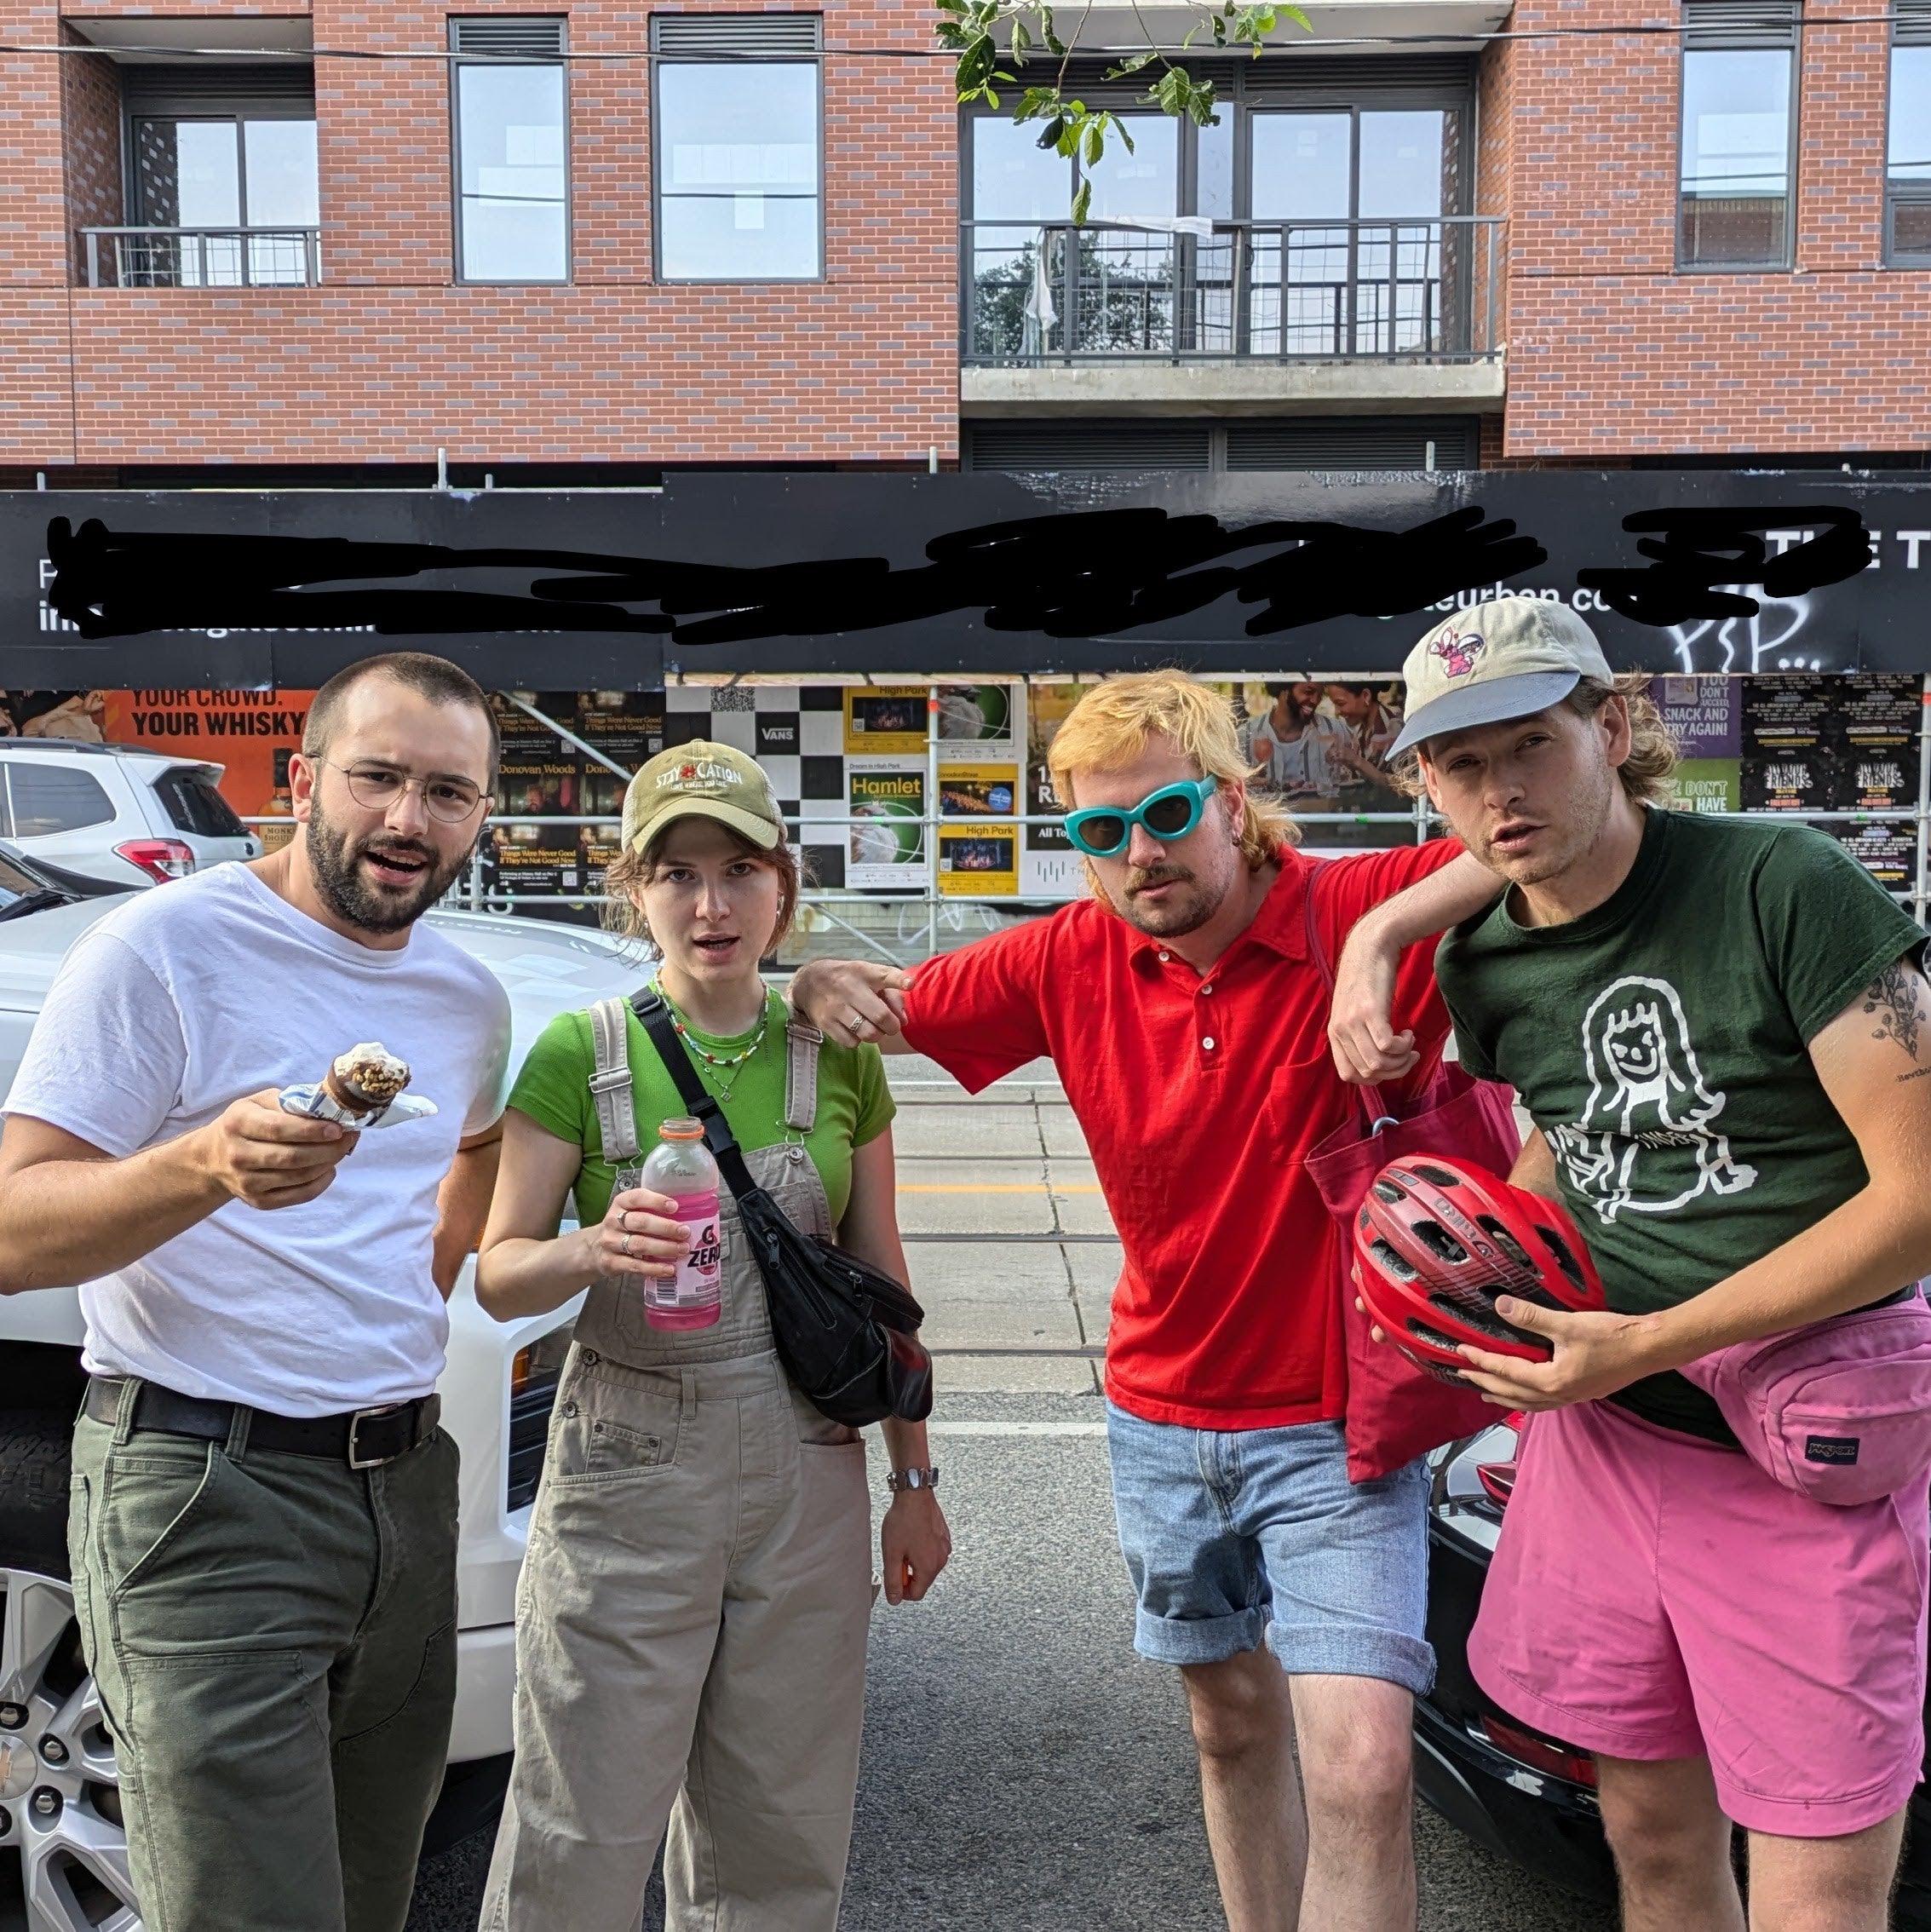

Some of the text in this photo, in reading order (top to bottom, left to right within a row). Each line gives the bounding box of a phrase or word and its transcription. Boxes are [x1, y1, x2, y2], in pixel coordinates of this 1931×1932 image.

[132, 689, 283, 707] YOUR CROWD.
[879, 686, 928, 696] High Park
[1664, 707, 1729, 722] SNACK AND
[131, 710, 306, 736] YOUR WHISKY
[1688, 722, 1728, 736] AGAIN!
[761, 727, 794, 740] VANS
[498, 763, 576, 775] Donovan Woods
[852, 776, 921, 795] Hamlet
[1685, 779, 1728, 796] DON'T
[1696, 796, 1728, 812] HAVE
[966, 825, 1014, 837] High Park
[1037, 827, 1053, 838] All
[558, 848, 577, 857] Good
